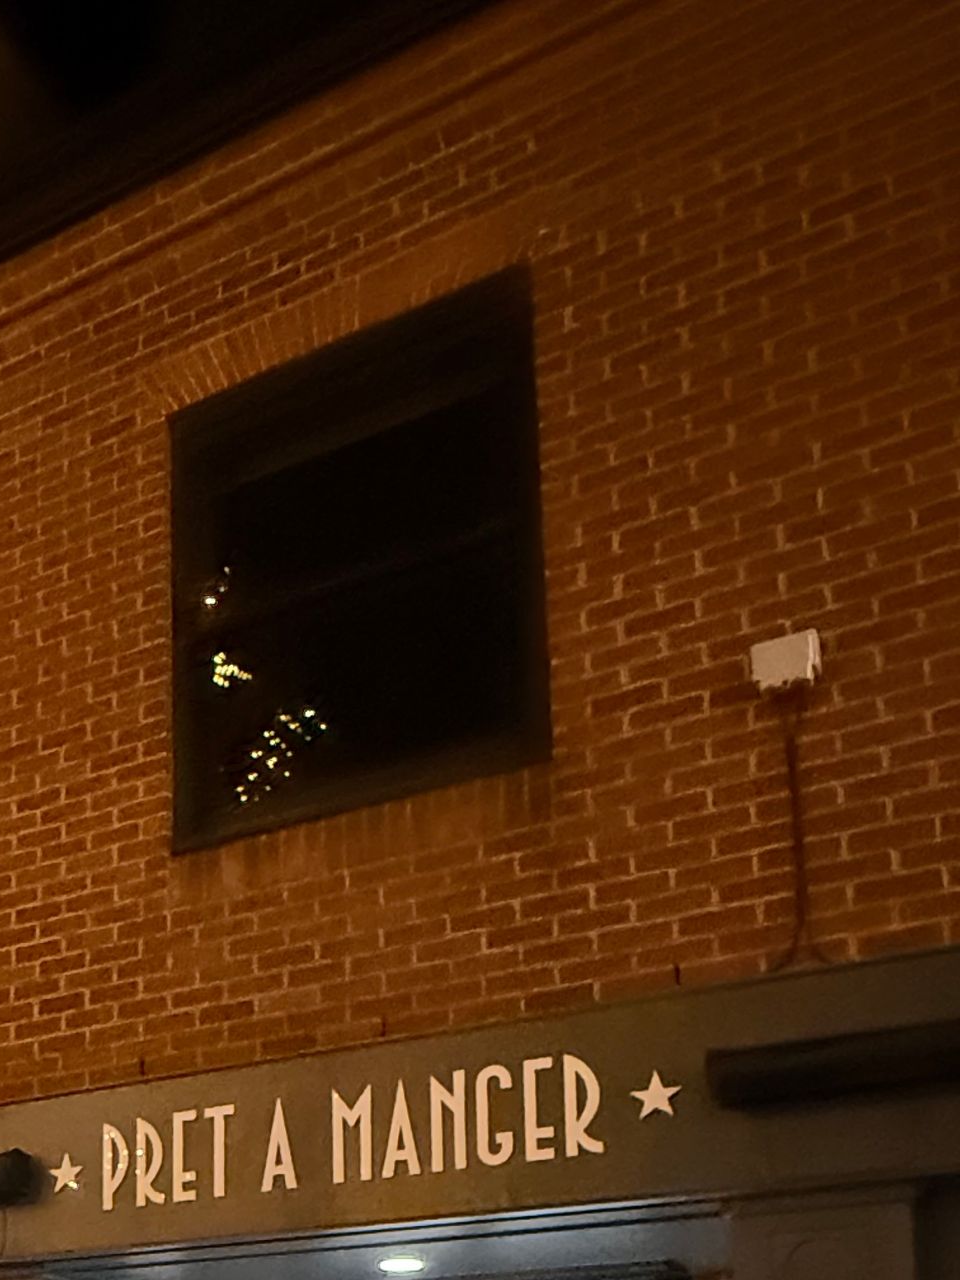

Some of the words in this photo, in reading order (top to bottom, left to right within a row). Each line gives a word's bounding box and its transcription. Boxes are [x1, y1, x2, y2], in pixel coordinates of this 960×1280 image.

[101, 1103, 235, 1211] PRET
[261, 1097, 298, 1193] A
[331, 1053, 605, 1185] MANGER
